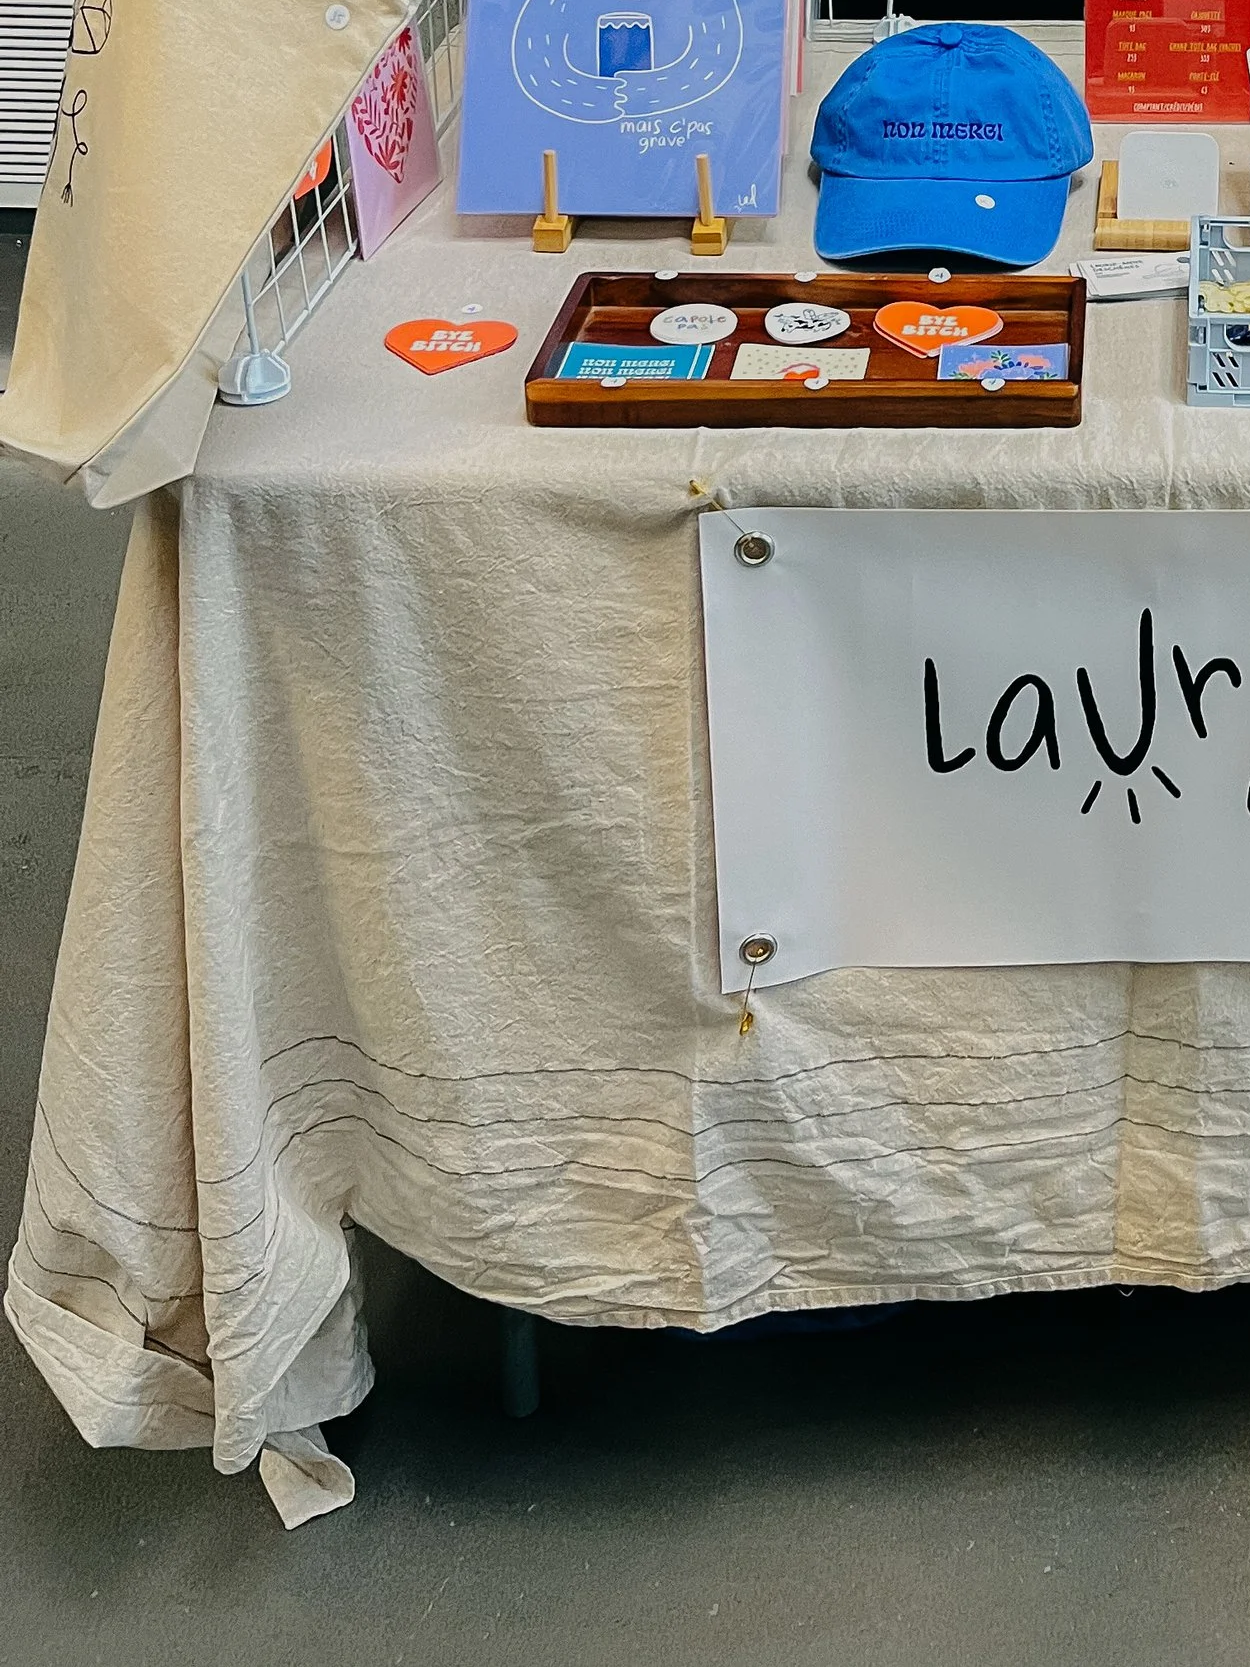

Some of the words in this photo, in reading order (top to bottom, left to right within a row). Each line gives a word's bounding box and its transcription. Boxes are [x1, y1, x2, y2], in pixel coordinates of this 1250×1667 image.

[621, 119, 662, 135] mais
[670, 118, 713, 139] c'pas
[639, 136, 685, 154] grave
[918, 315, 958, 326] BYE
[430, 330, 475, 341] BYE
[901, 325, 968, 336] BITCH
[409, 340, 482, 352] BITCH
